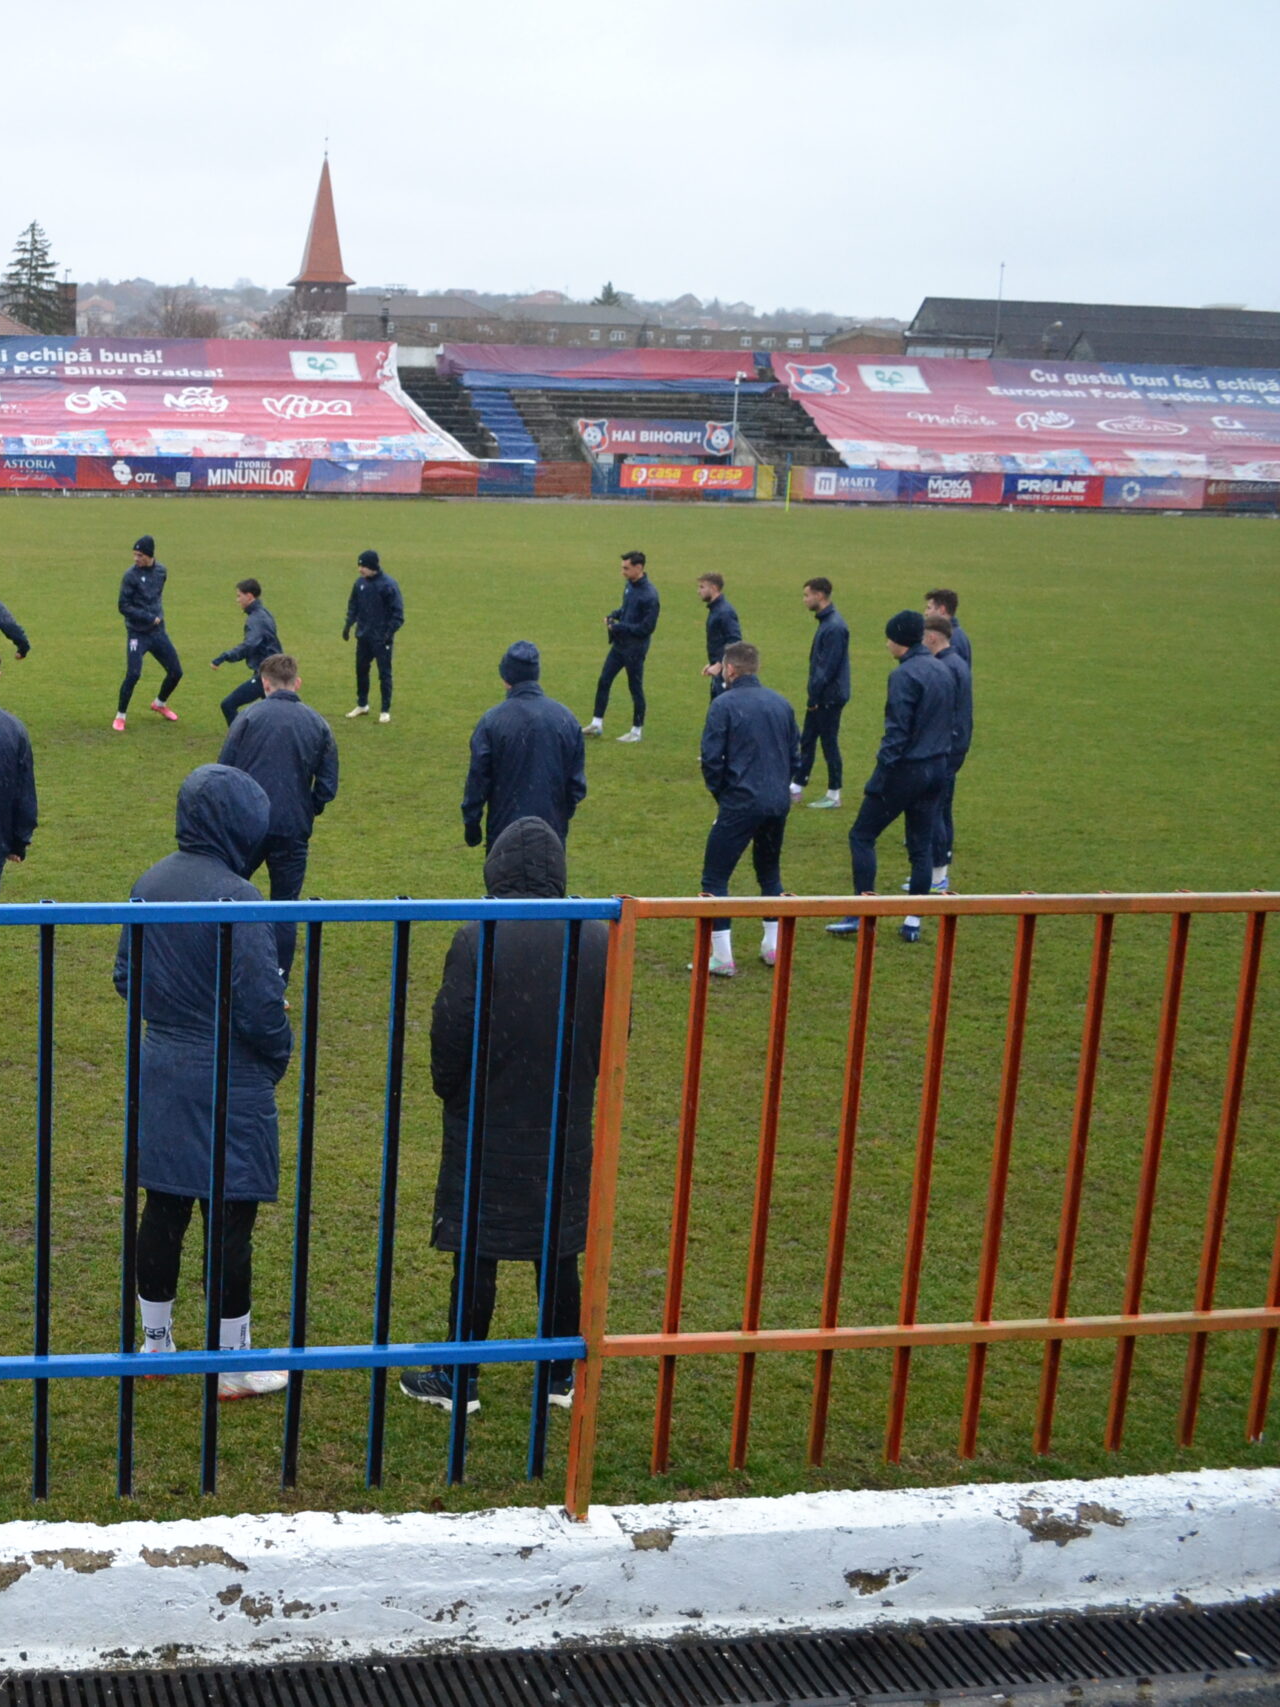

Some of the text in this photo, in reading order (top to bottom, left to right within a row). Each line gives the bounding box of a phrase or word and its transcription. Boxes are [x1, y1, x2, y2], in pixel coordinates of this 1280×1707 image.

[16, 347, 93, 364] echipă
[100, 348, 164, 364] bună!
[134, 366, 224, 378] Oradea!
[1030, 368, 1280, 394] Cu gustul bun faci echipă
[985, 386, 1088, 398] European
[261, 393, 353, 419] Viva
[611, 430, 636, 443] HAI
[3, 459, 57, 471] ASTORIA
[235, 460, 273, 469] IZVORUL
[135, 472, 158, 483] OTL
[207, 468, 296, 487] MINUNILOR
[647, 468, 682, 479] casa
[709, 468, 743, 480] casa
[839, 476, 877, 487] MARTY
[928, 479, 970, 489] MOKA
[1018, 479, 1086, 493] PROLINE
